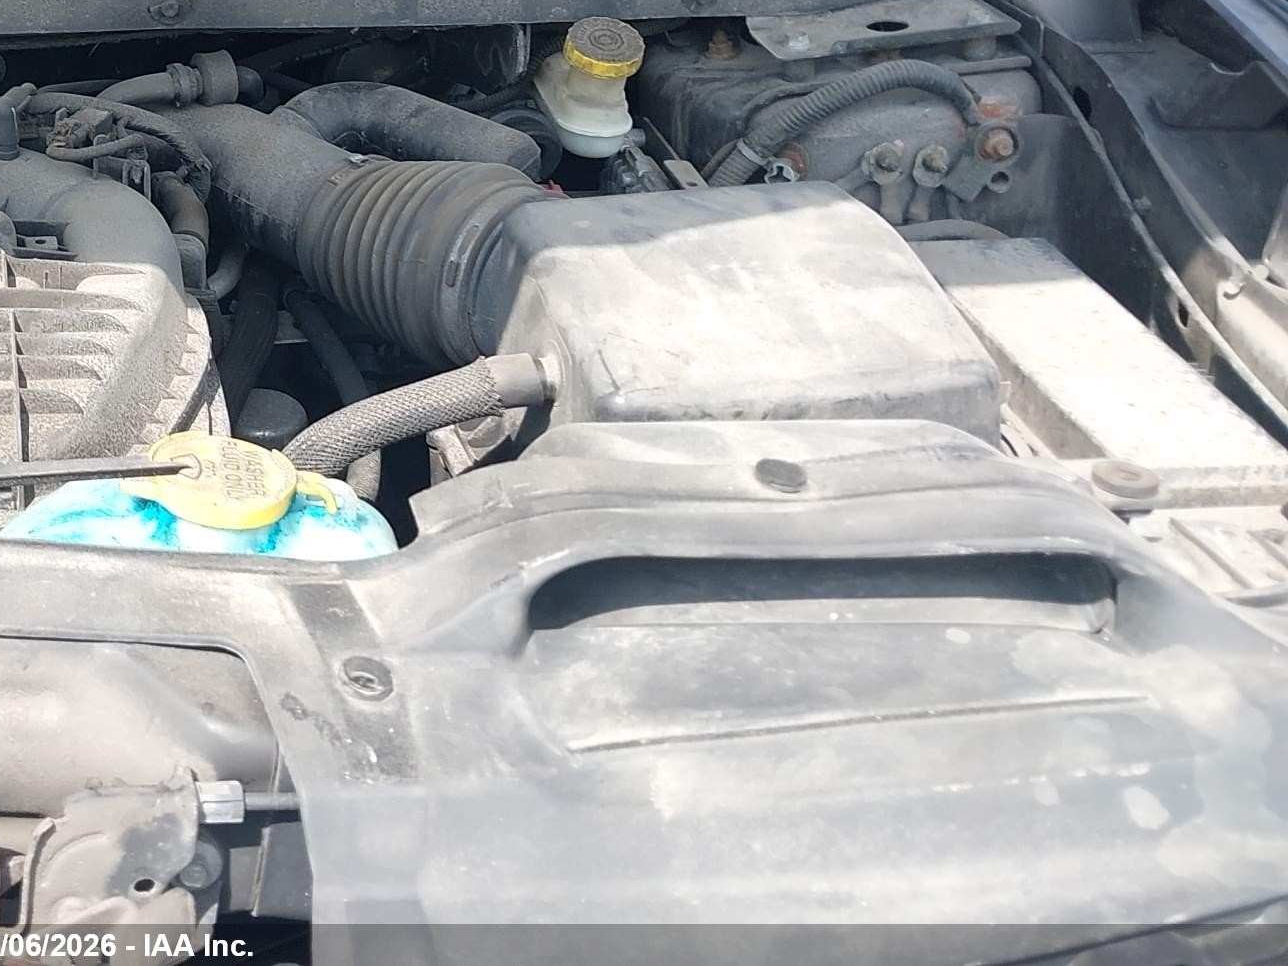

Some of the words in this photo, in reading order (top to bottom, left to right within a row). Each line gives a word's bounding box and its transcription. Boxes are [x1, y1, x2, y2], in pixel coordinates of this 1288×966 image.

[221, 440, 240, 471] FLUID
[225, 473, 246, 502] ONLY
[241, 450, 266, 498] WASHER
